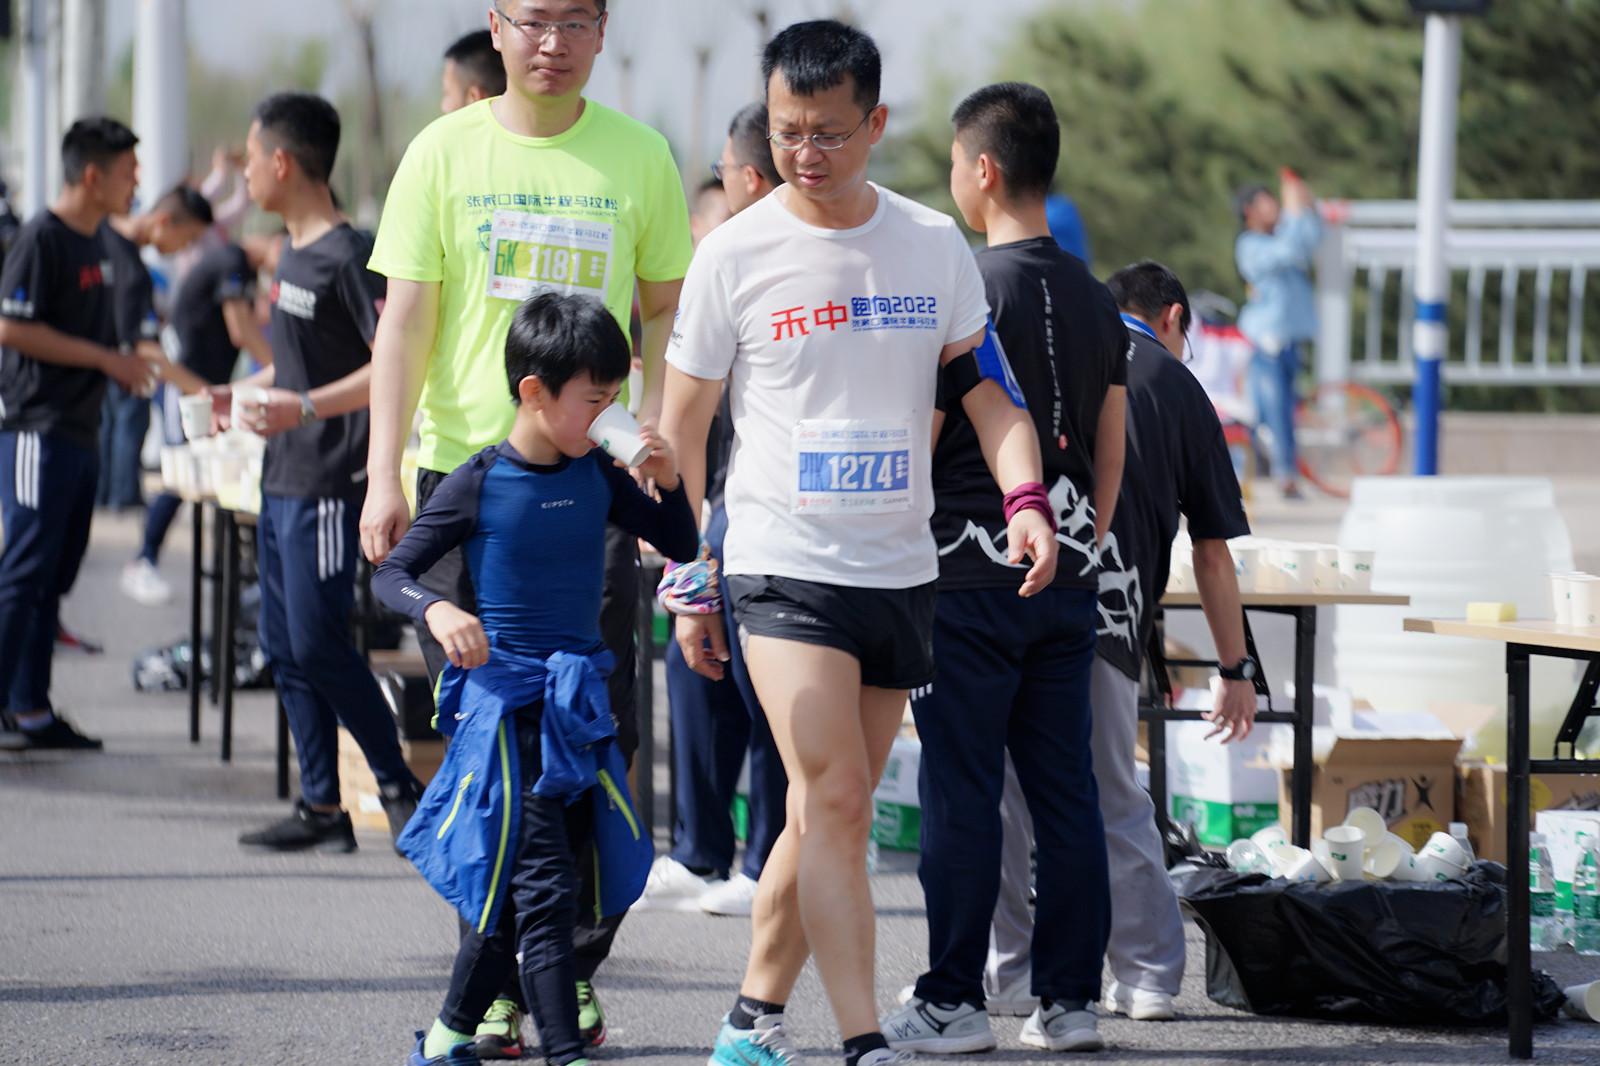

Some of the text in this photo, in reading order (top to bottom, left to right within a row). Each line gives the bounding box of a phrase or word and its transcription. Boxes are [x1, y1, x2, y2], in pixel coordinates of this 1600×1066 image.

[495, 238, 518, 275] 6K
[528, 247, 581, 284] 1181
[851, 297, 936, 317] 跑向2022
[828, 454, 893, 489] 1274
